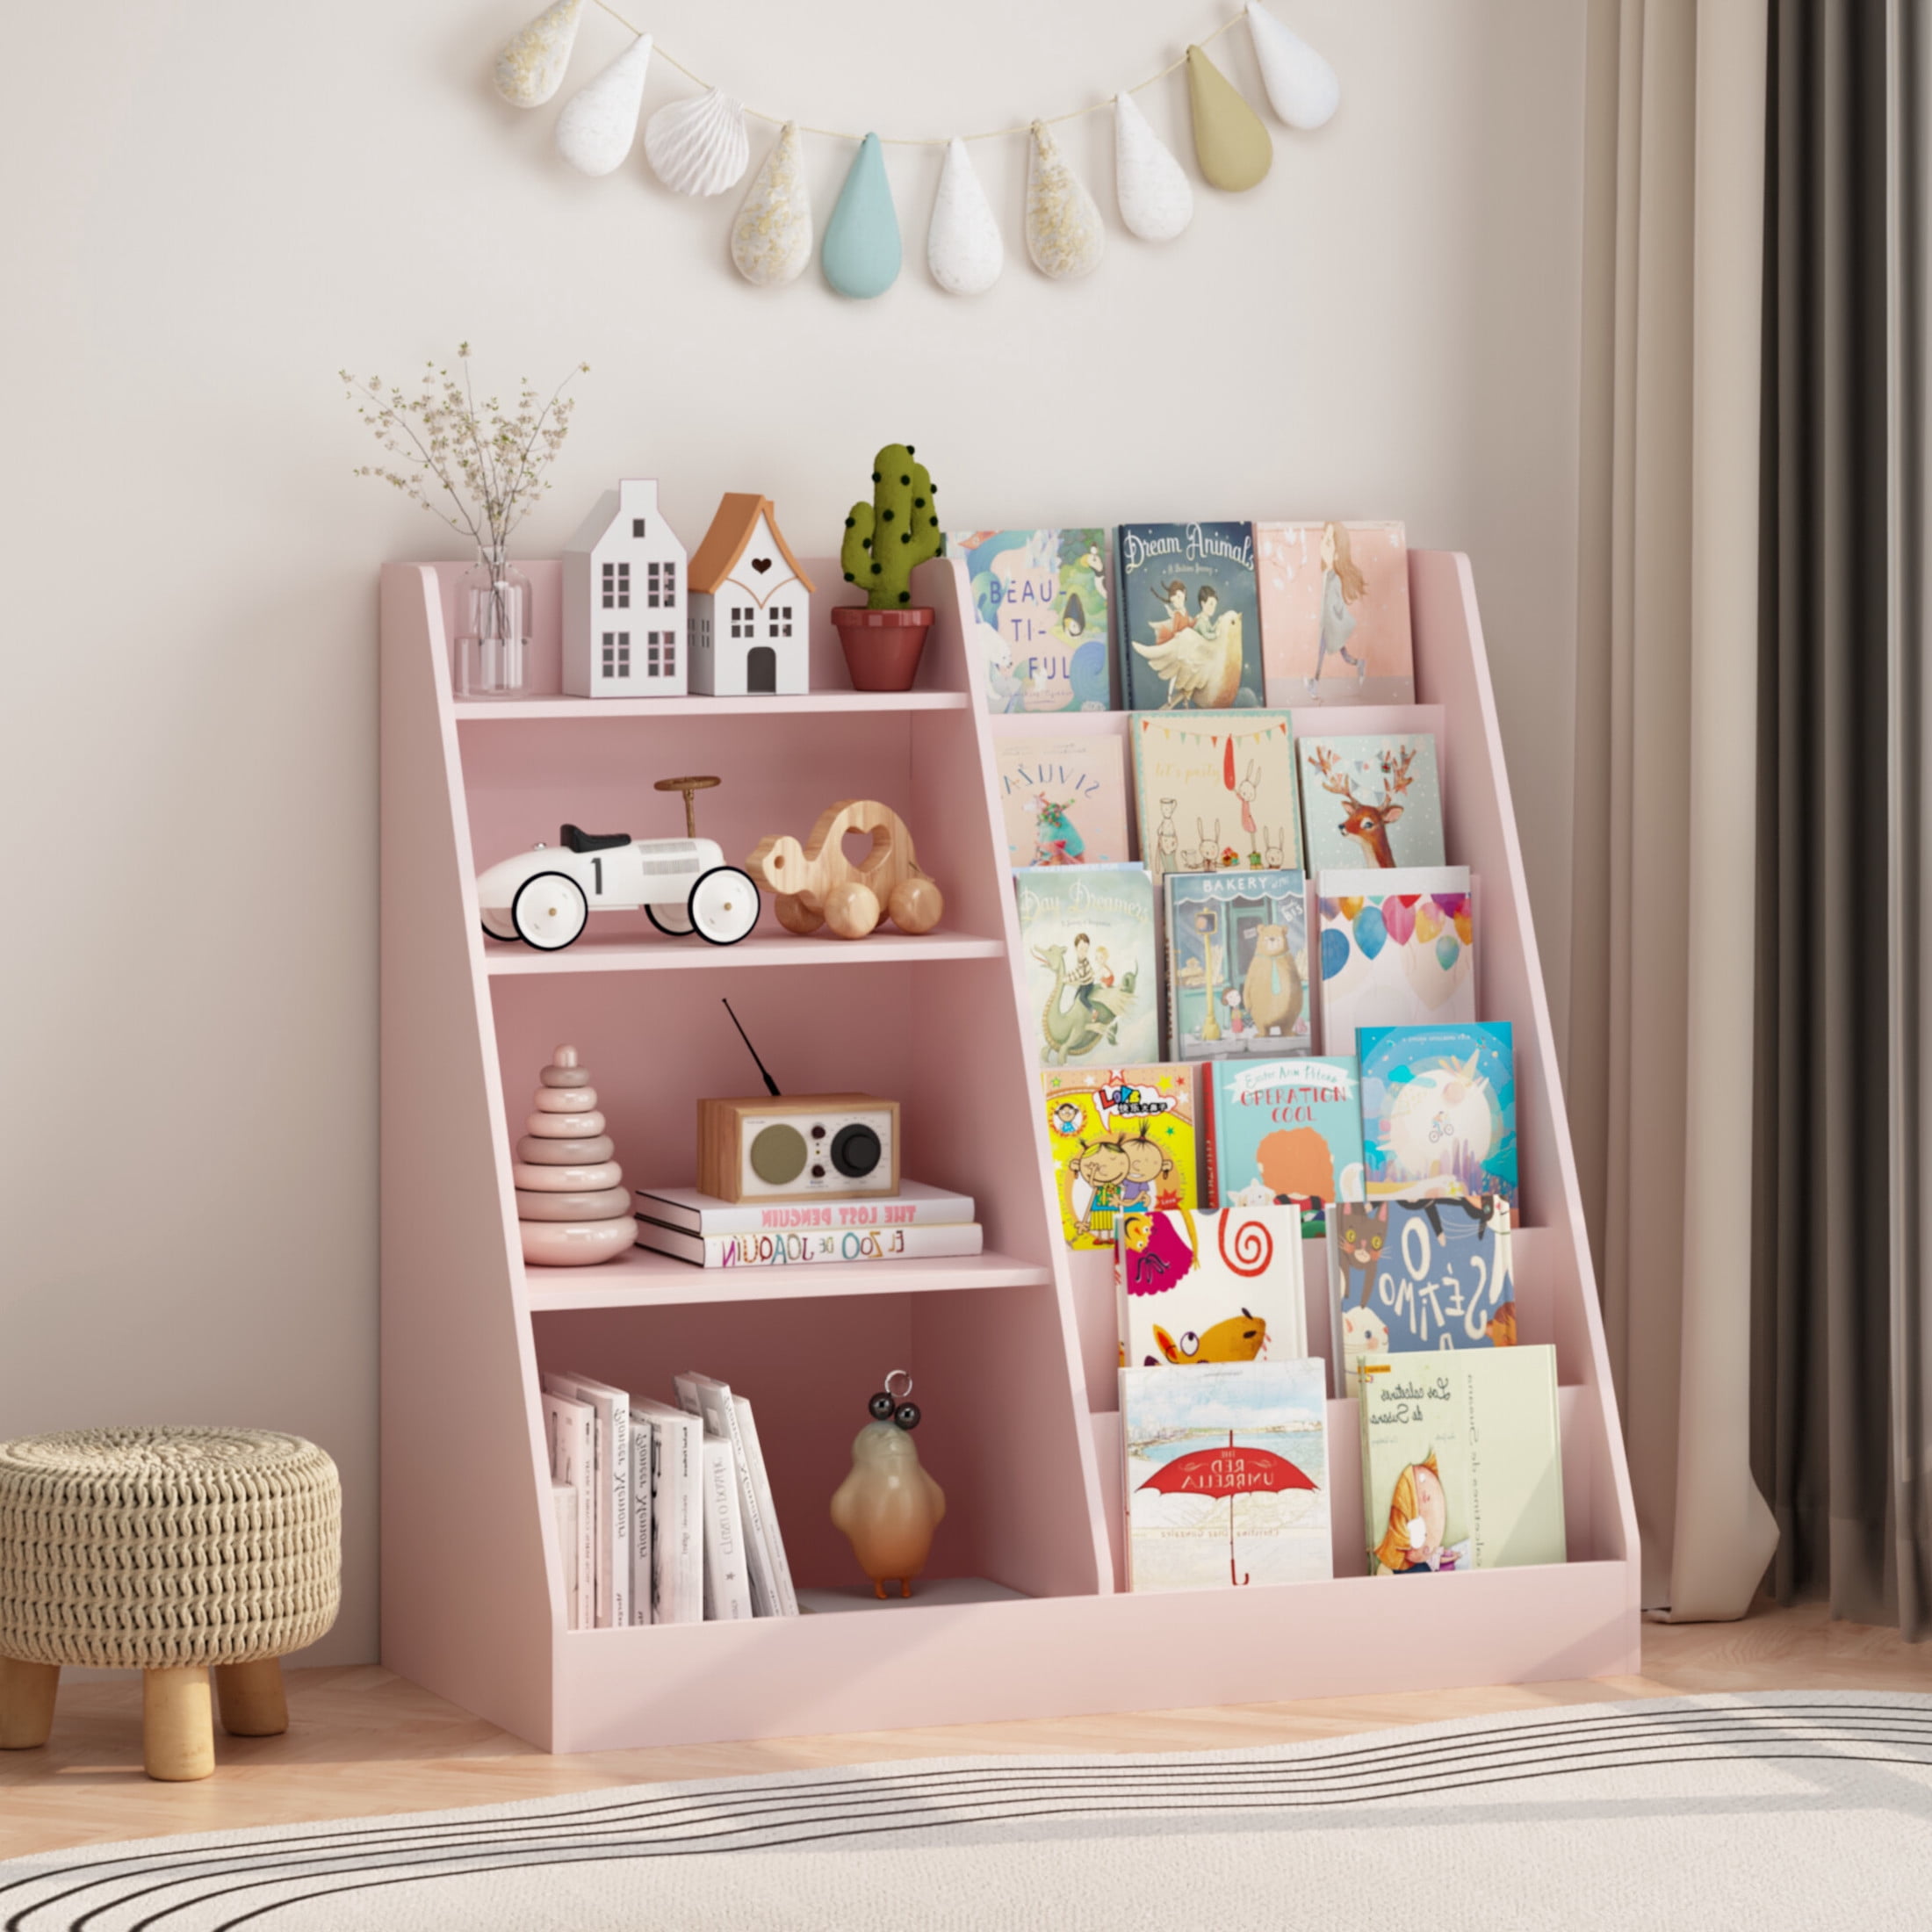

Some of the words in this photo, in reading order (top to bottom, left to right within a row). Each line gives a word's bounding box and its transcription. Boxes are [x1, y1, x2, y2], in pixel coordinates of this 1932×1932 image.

[1123, 530, 1182, 574] Dream
[1186, 522, 1255, 571] Animals
[990, 580, 1067, 604] BEAU-
[1011, 618, 1047, 642] TI-
[1028, 656, 1070, 680] FUL
[590, 857, 603, 895] 1
[1202, 876, 1267, 893] BAKERY
[1240, 1085, 1347, 1107] OPERATION
[1272, 1105, 1317, 1123] COOL
